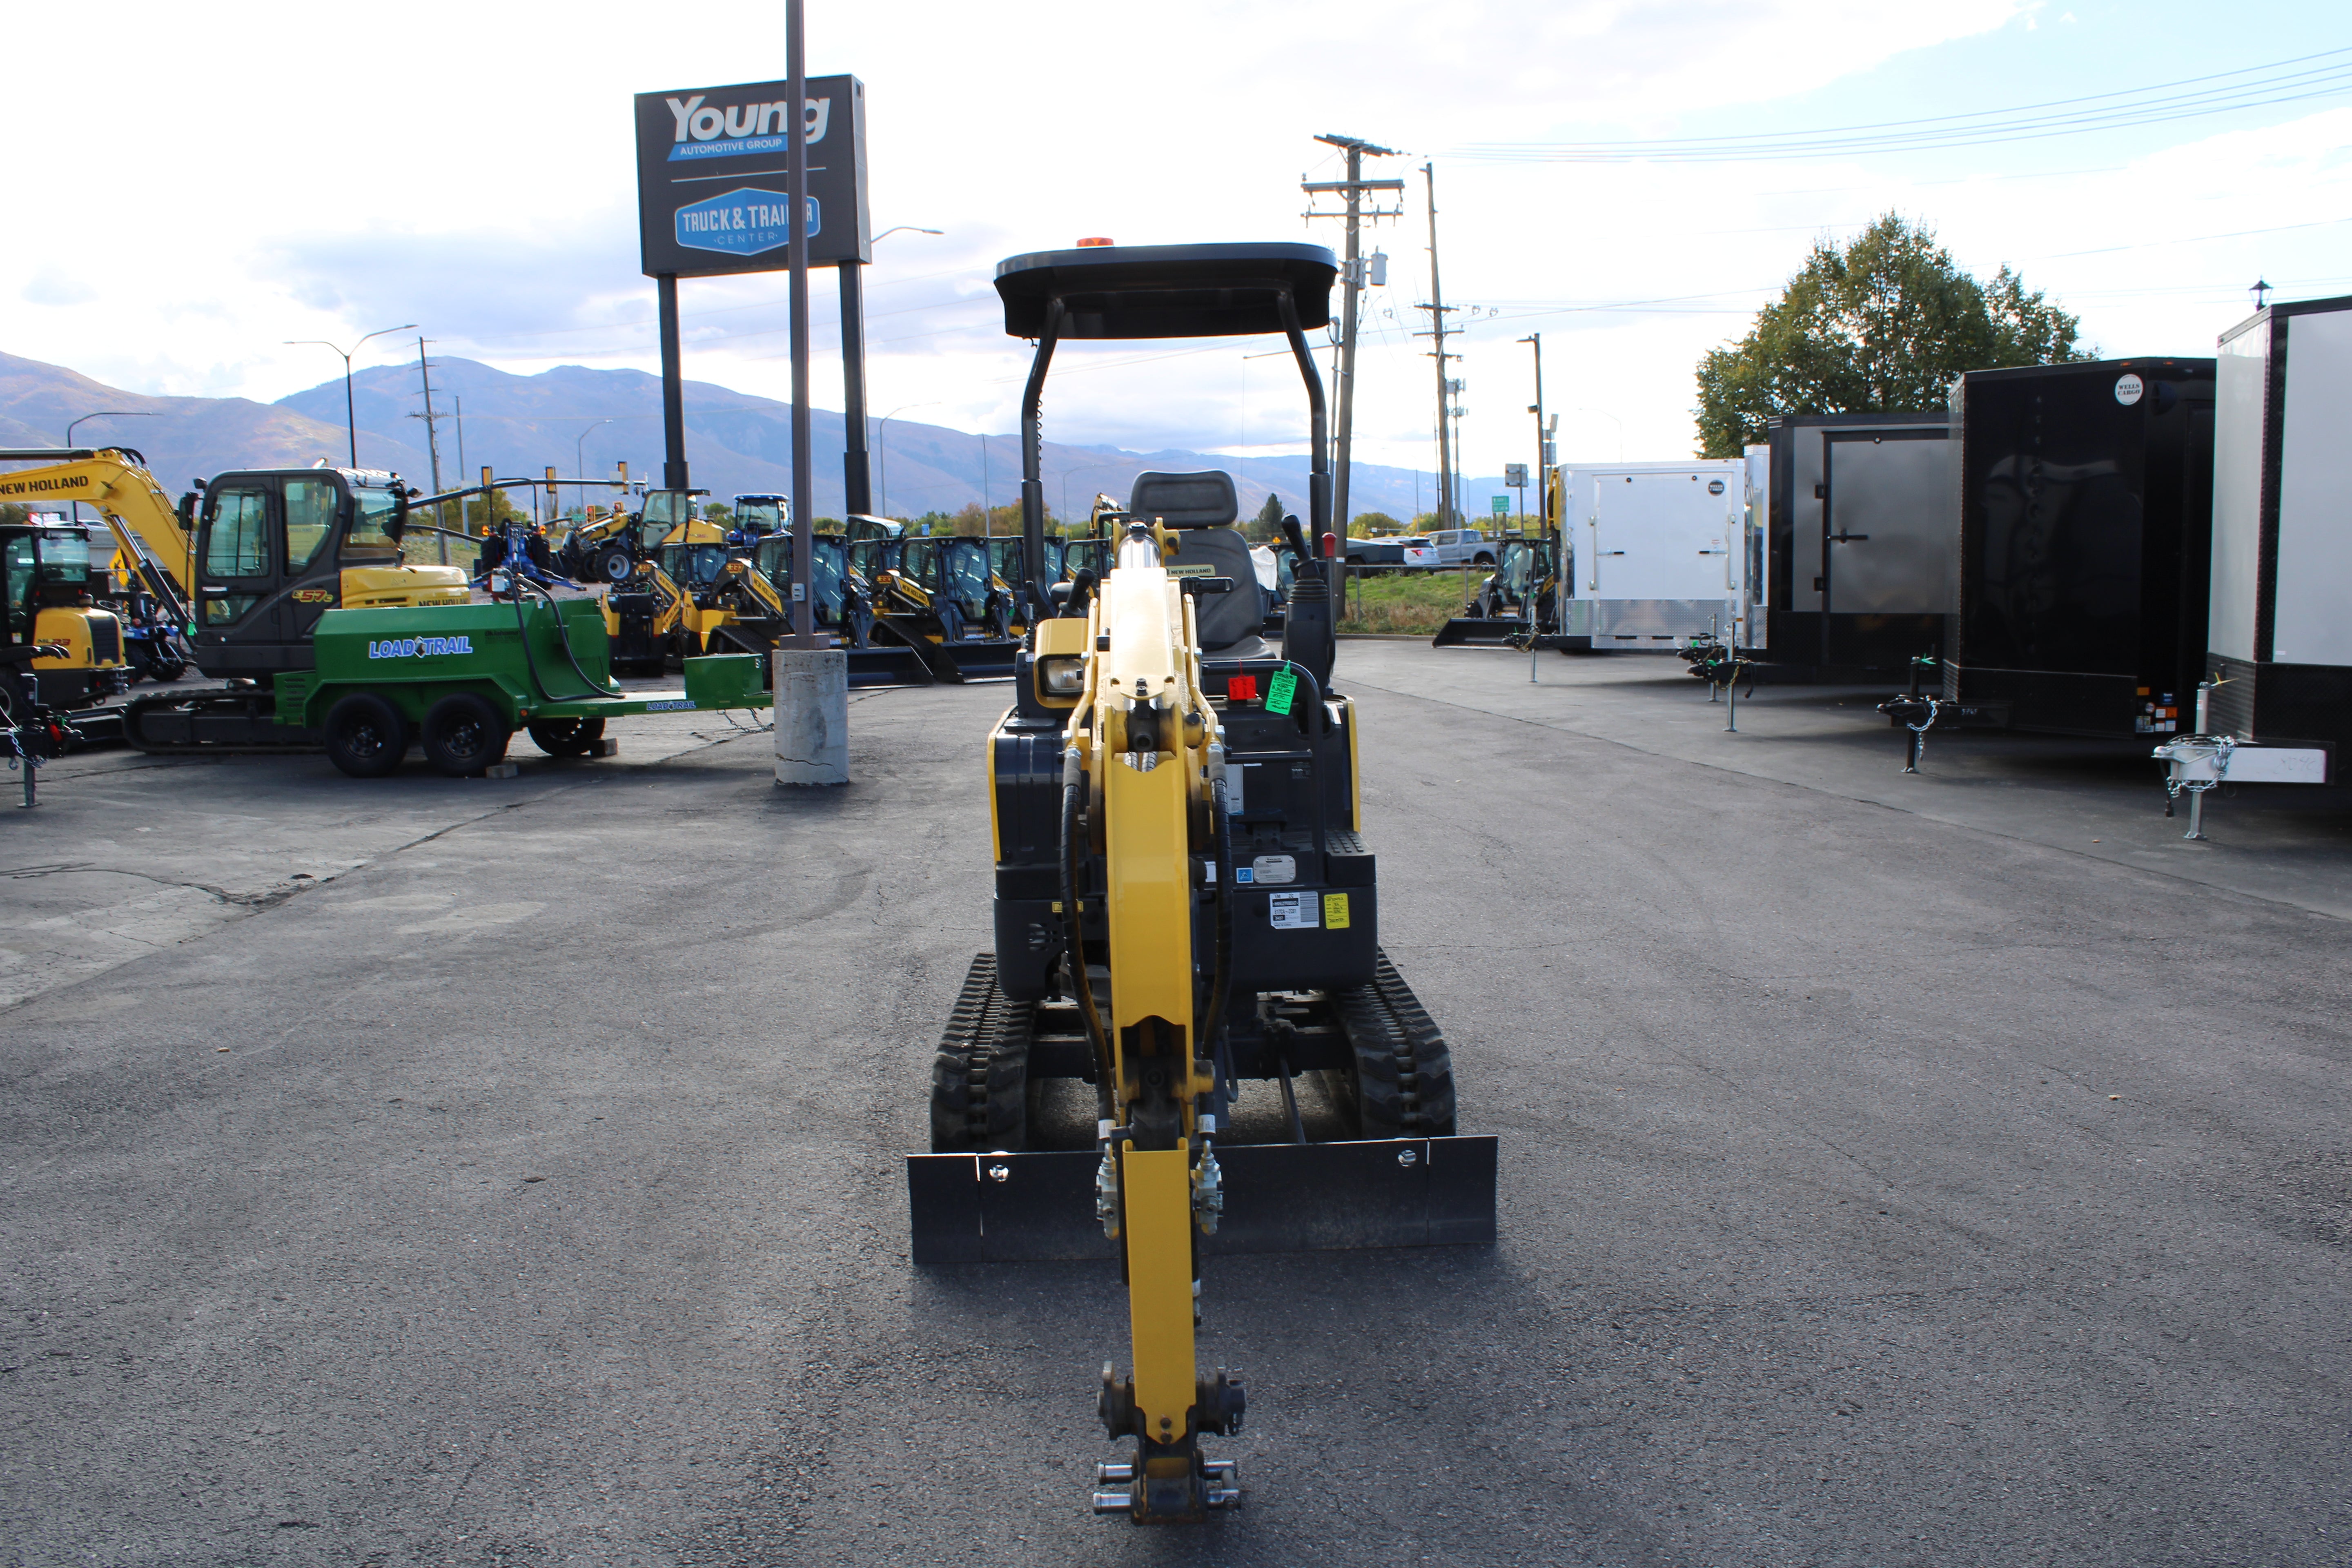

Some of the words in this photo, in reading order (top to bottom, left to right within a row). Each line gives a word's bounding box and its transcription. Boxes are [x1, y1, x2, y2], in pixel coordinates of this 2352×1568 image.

[666, 96, 830, 145] Young
[680, 141, 744, 156] AUTOMOTIVE
[746, 138, 782, 149] GROUP
[683, 209, 731, 232] TRUCK
[733, 207, 746, 230] &
[717, 232, 775, 245] CENTER
[0, 482, 25, 495] NEW
[29, 475, 89, 492] HOLLAND
[910, 589, 927, 602] HOLLAND
[369, 639, 416, 659] LOAD
[423, 636, 473, 655] TRAIL
[647, 702, 669, 710] LOAD
[673, 701, 696, 709] TRAIL
